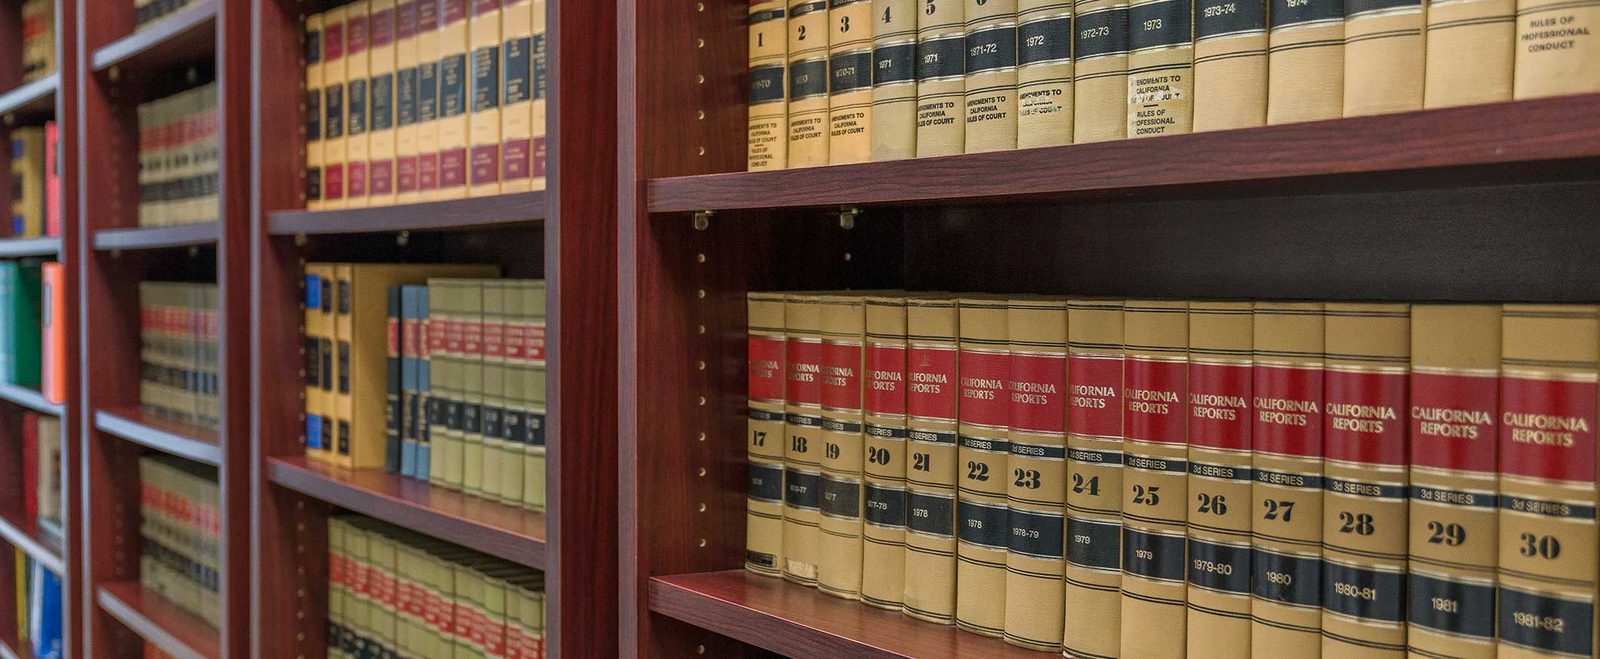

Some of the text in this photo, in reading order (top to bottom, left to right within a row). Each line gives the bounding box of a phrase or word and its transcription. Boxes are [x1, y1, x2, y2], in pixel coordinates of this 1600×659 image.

[881, 6, 892, 23] 4
[926, 0, 936, 15] 5
[1204, 3, 1235, 17] 1973-74
[840, 16, 850, 33] 3
[1143, 18, 1162, 31] 1973
[1530, 16, 1574, 28] RULES OF
[757, 32, 763, 47] 1
[798, 25, 806, 40] 2
[1080, 26, 1109, 39] 1972-73
[1026, 35, 1044, 47] 1972
[1528, 40, 1574, 53] CONDUCT
[970, 43, 997, 56] 1971-72
[879, 59, 892, 69] 1971
[924, 53, 938, 63] 1971
[1136, 85, 1170, 95] CALIFORNIA
[970, 105, 998, 114] CALIFORNIA
[985, 112, 1006, 120] COURT
[1137, 110, 1155, 118] RULES
[933, 117, 955, 125] COURT
[1136, 126, 1165, 135] CONDUCT
[1125, 388, 1179, 403] CALIFORNIA
[1190, 392, 1246, 409] CALIFORNIA
[1129, 401, 1169, 414] REPORTS
[1254, 396, 1318, 413] CALIFORNIA
[1326, 402, 1396, 420] CALIFORNIA
[1193, 407, 1236, 420] REPORTS
[1259, 411, 1307, 426] REPORTS
[1411, 406, 1492, 426] CALIFORNIA
[1333, 417, 1384, 434] REPORTS
[1503, 411, 1589, 433] CALIFORNIA
[915, 433, 938, 442] SERIES
[1420, 422, 1478, 439] REPORTS
[1512, 428, 1574, 448] REPORTS
[753, 430, 767, 447] 17
[792, 435, 808, 453] 18
[970, 441, 992, 450] SERIES
[826, 442, 840, 459] 19
[869, 446, 890, 465] 20
[1017, 446, 1045, 456] SERIES
[1075, 451, 1103, 462] SERIES
[913, 452, 930, 472] 21
[1129, 457, 1167, 470] 3d SERIES
[968, 461, 989, 481] 22
[1193, 464, 1234, 478] 3d SERIES
[1014, 468, 1041, 490] 23
[1073, 472, 1101, 497] 24
[1259, 471, 1304, 487] 3d SERIES
[1132, 485, 1160, 506] 25
[1333, 481, 1382, 496] 3d SERIES
[1197, 492, 1227, 516] 26
[1421, 488, 1474, 506] 3d SERIES
[913, 508, 929, 518] 1978
[1263, 499, 1295, 522] 27
[1512, 499, 1569, 517] 3d SERIES
[967, 519, 983, 529] 1978
[1339, 511, 1375, 536] 28
[1012, 527, 1040, 540] 1978-79
[1074, 534, 1091, 545] 1979
[1427, 520, 1466, 547] 29
[1520, 532, 1561, 560] 30
[1135, 549, 1153, 561] 1979
[1193, 559, 1233, 576] 1979-80
[1265, 571, 1292, 586] 1980
[1334, 581, 1377, 601] 1980-81
[1431, 597, 1458, 614] 1981
[1512, 611, 1566, 634] 1981-82
